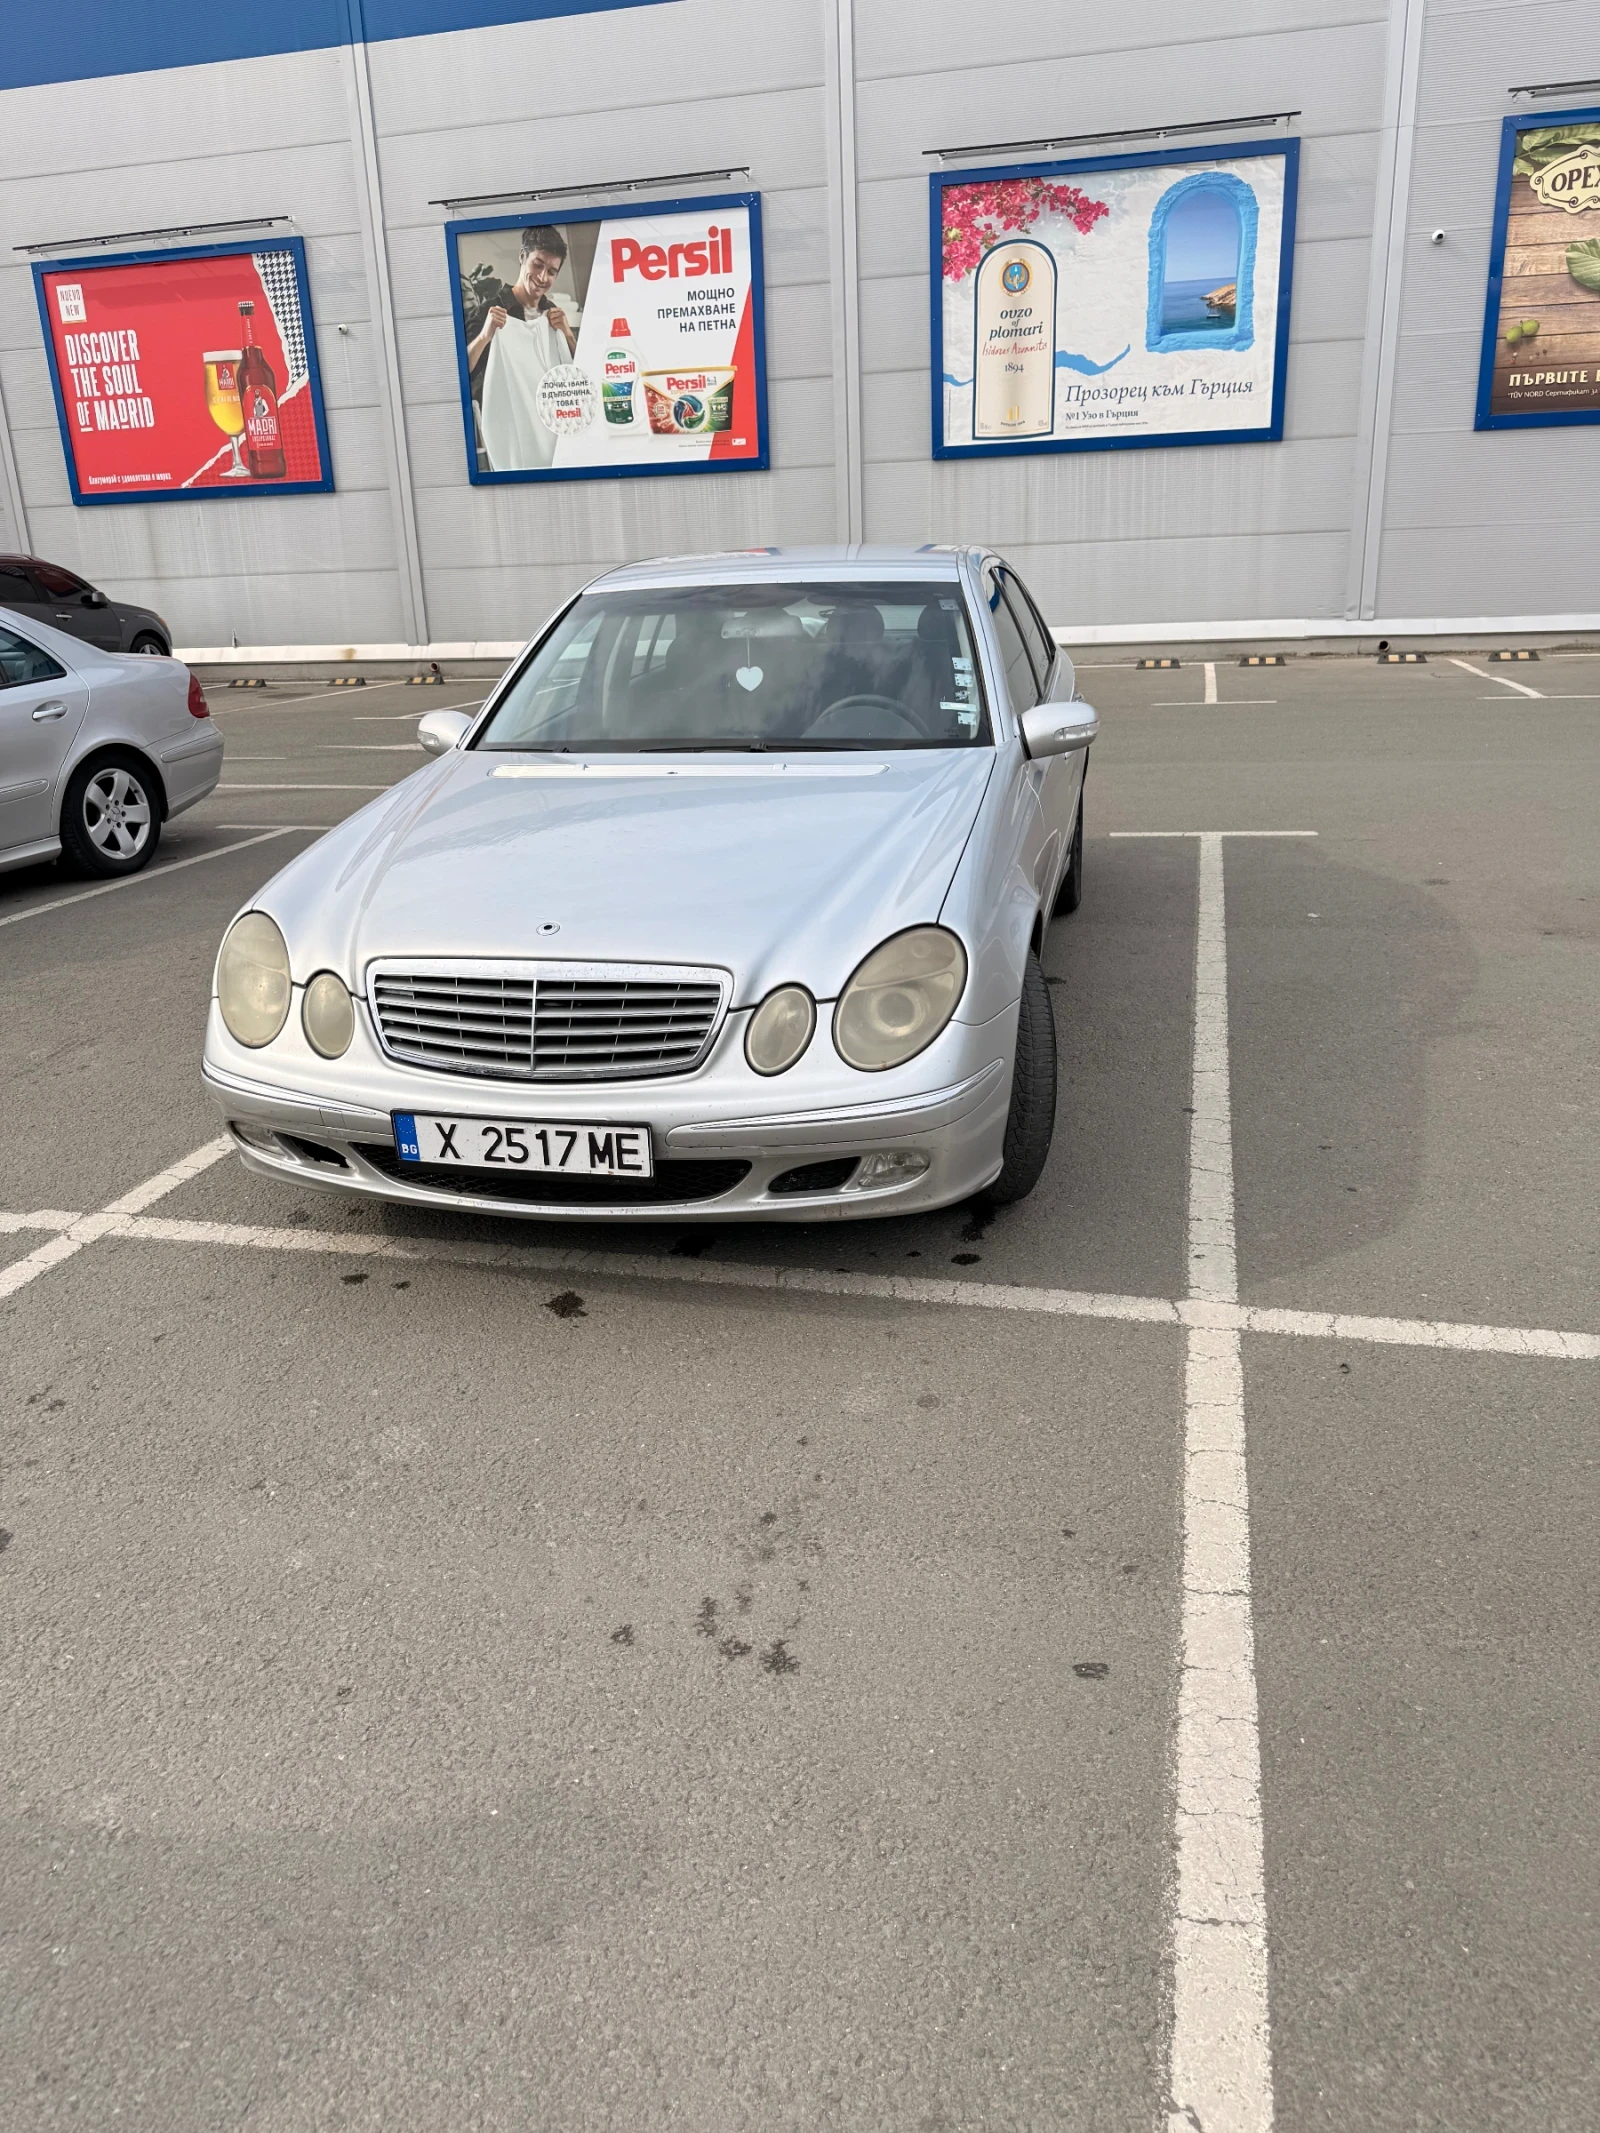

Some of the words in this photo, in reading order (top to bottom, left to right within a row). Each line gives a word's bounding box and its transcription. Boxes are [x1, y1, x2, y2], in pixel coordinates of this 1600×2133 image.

[611, 226, 733, 283] Persil
[59, 289, 81, 302] NUEVO
[687, 287, 735, 302] МОЩНО
[65, 304, 80, 317] NEW
[657, 303, 736, 319] ПРЕМАХВАНЕ
[679, 321, 696, 333] НА
[698, 319, 737, 332] ПЕТНА
[1011, 318, 1021, 327] of
[989, 321, 1044, 341] plomari
[64, 329, 140, 366] DISCOVER
[605, 361, 636, 375] Persil
[1005, 362, 1025, 374] 1894
[70, 367, 101, 398] THE
[102, 363, 143, 397] SOUL
[543, 380, 590, 389] ПОЧИСТВАНЕ
[666, 374, 707, 391] Persil
[1509, 370, 1589, 387] ПЪРВИТЕ
[1065, 384, 1148, 407] Прозорец
[1151, 382, 1185, 397] към
[1189, 378, 1254, 400] Гърция
[1523, 390, 1544, 398] NORD
[556, 399, 574, 407] ТОВА
[76, 401, 94, 432] OF
[94, 397, 155, 431] MADRID
[555, 407, 582, 419] Persil
[1082, 411, 1098, 420] Узо
[1105, 409, 1139, 419] Гърция
[247, 418, 278, 436] MADRI
[401, 1143, 418, 1155] BG
[435, 1122, 462, 1160] X
[481, 1126, 578, 1167] 2517
[588, 1131, 643, 1171] ME
